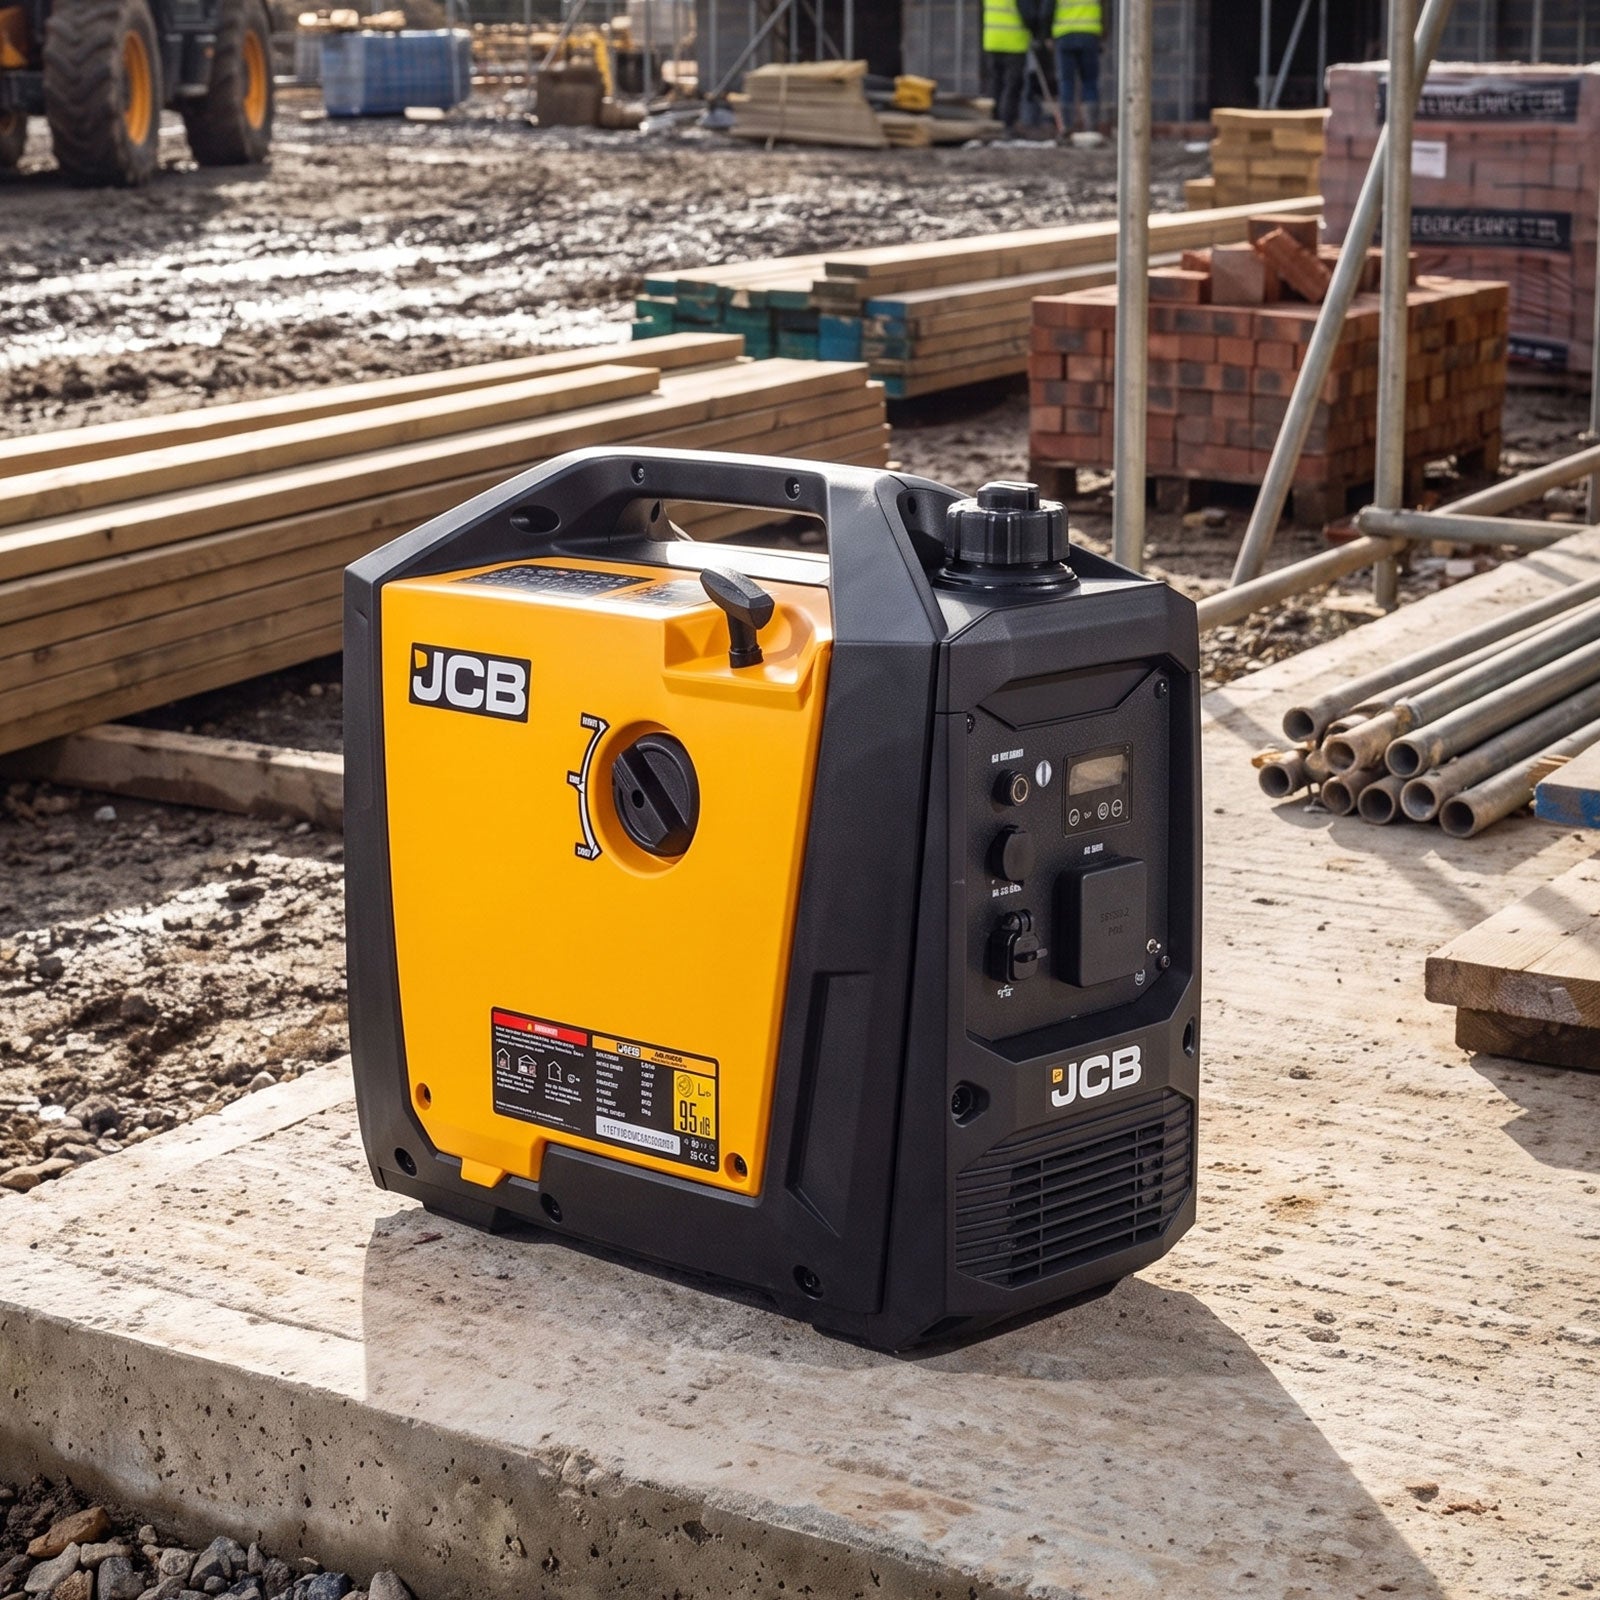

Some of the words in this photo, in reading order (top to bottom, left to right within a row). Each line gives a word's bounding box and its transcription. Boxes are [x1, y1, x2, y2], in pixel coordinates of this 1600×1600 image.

[412, 650, 527, 716] JCB
[1051, 1045, 1142, 1107] JCB
[679, 1100, 698, 1133] 95
